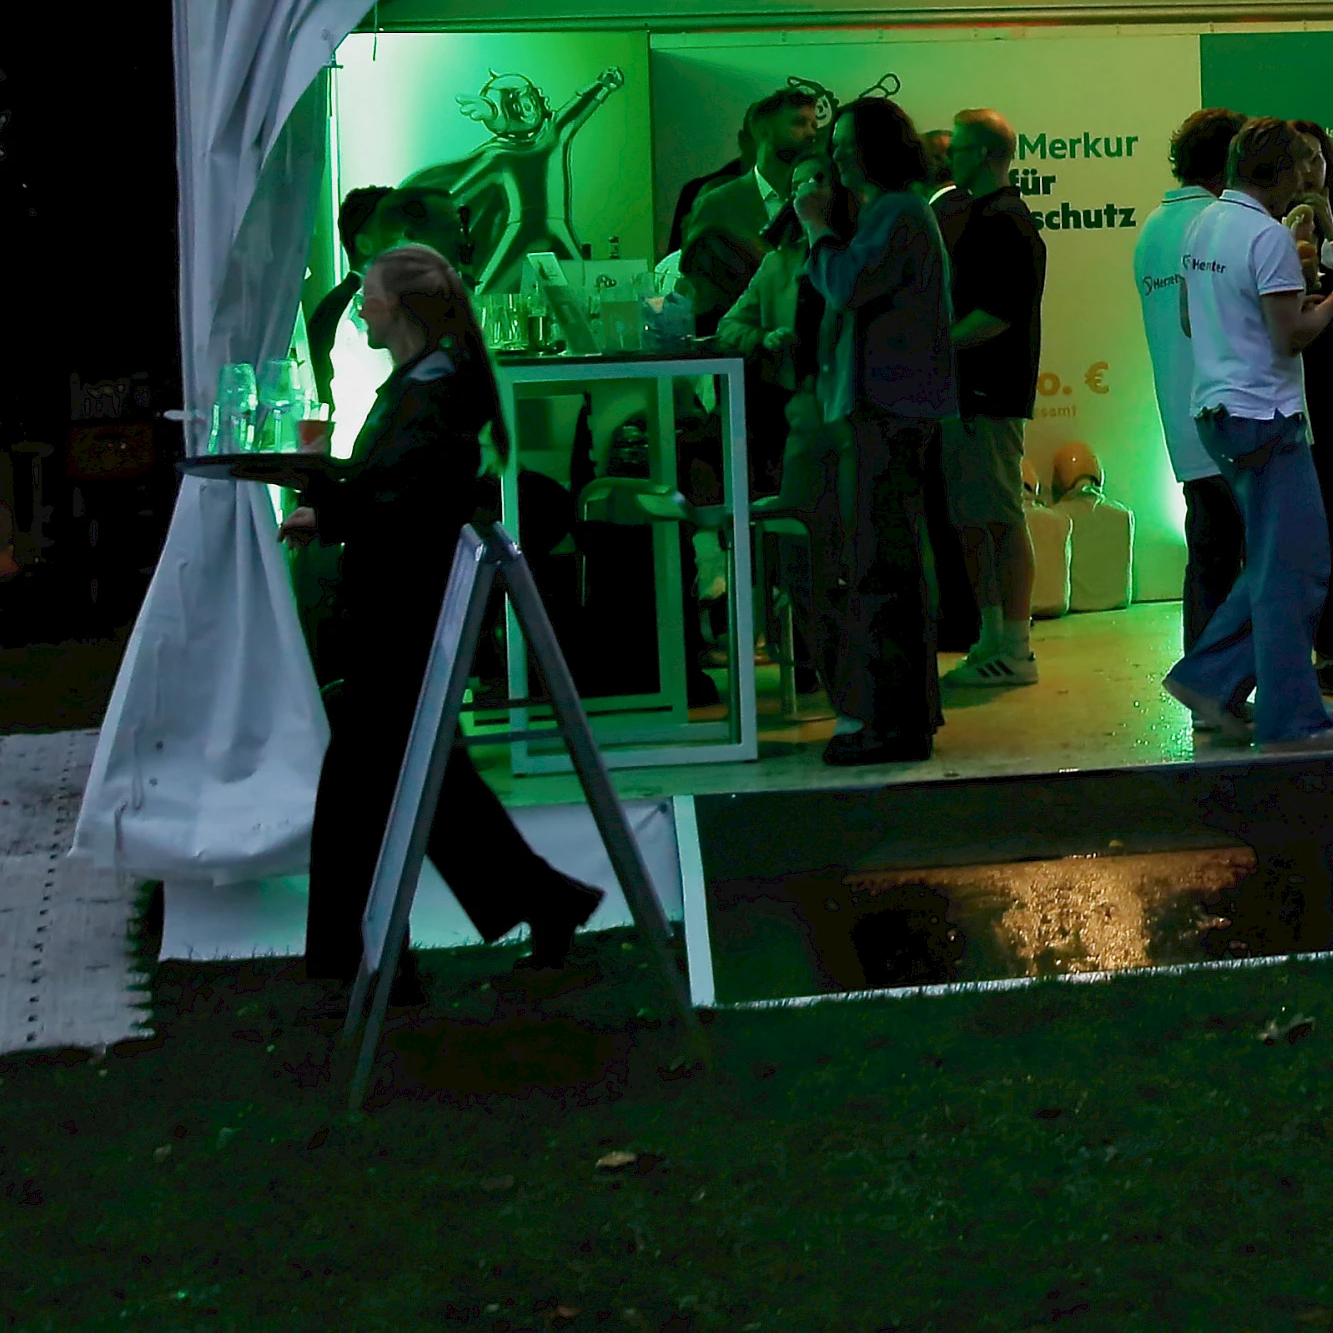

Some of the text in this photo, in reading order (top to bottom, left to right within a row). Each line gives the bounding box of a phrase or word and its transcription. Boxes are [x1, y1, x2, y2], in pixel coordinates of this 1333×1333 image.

[1012, 131, 1139, 160] Merkur
[1008, 168, 1056, 196] für
[1030, 202, 1137, 231] schutz
[1084, 361, 1110, 395] €
